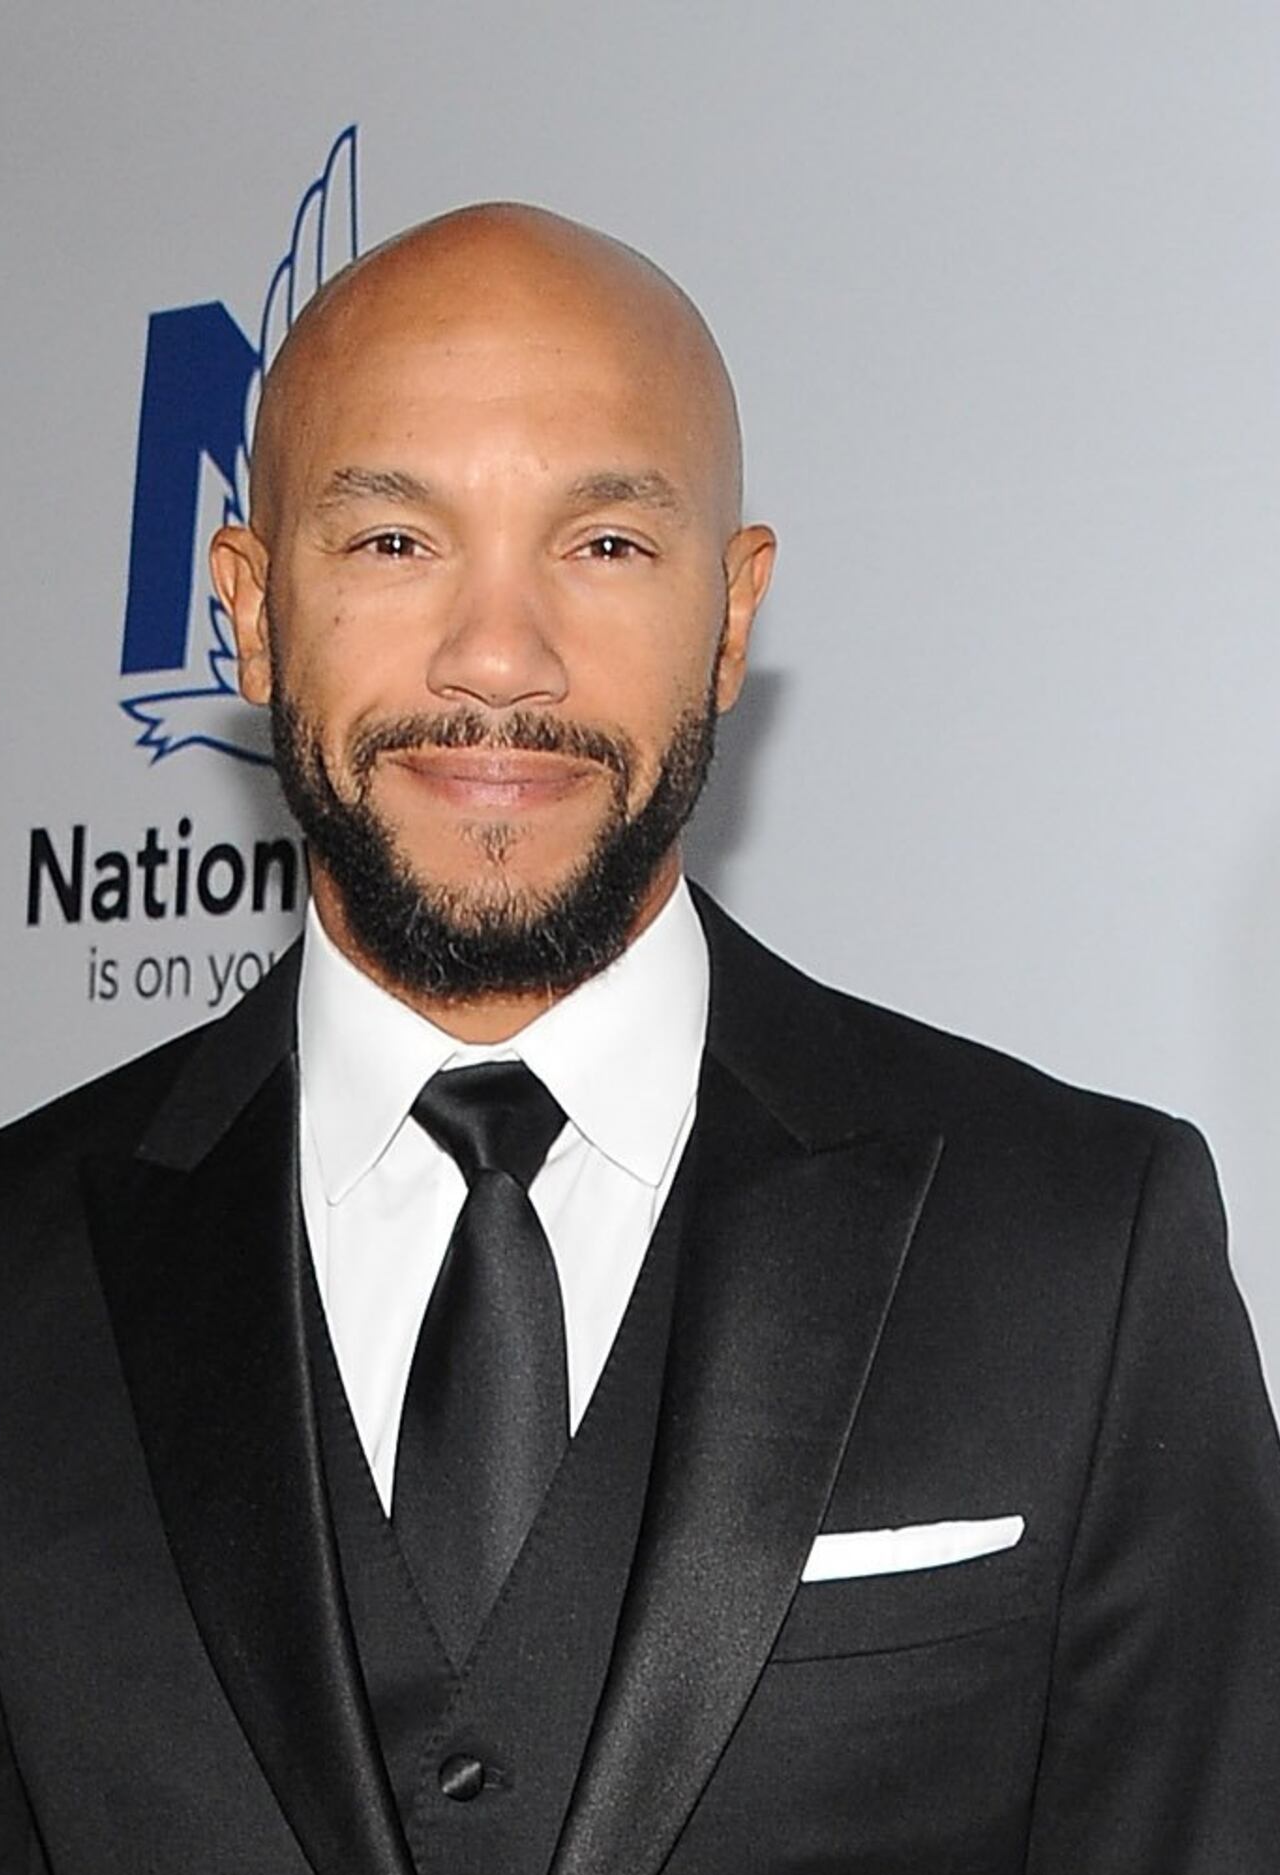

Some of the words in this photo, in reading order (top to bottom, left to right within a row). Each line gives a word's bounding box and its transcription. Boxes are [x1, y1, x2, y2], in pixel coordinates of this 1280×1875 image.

[26, 816, 312, 926] Nation
[88, 946, 119, 1001] is
[135, 955, 191, 998] on
[208, 950, 274, 1006] yo
